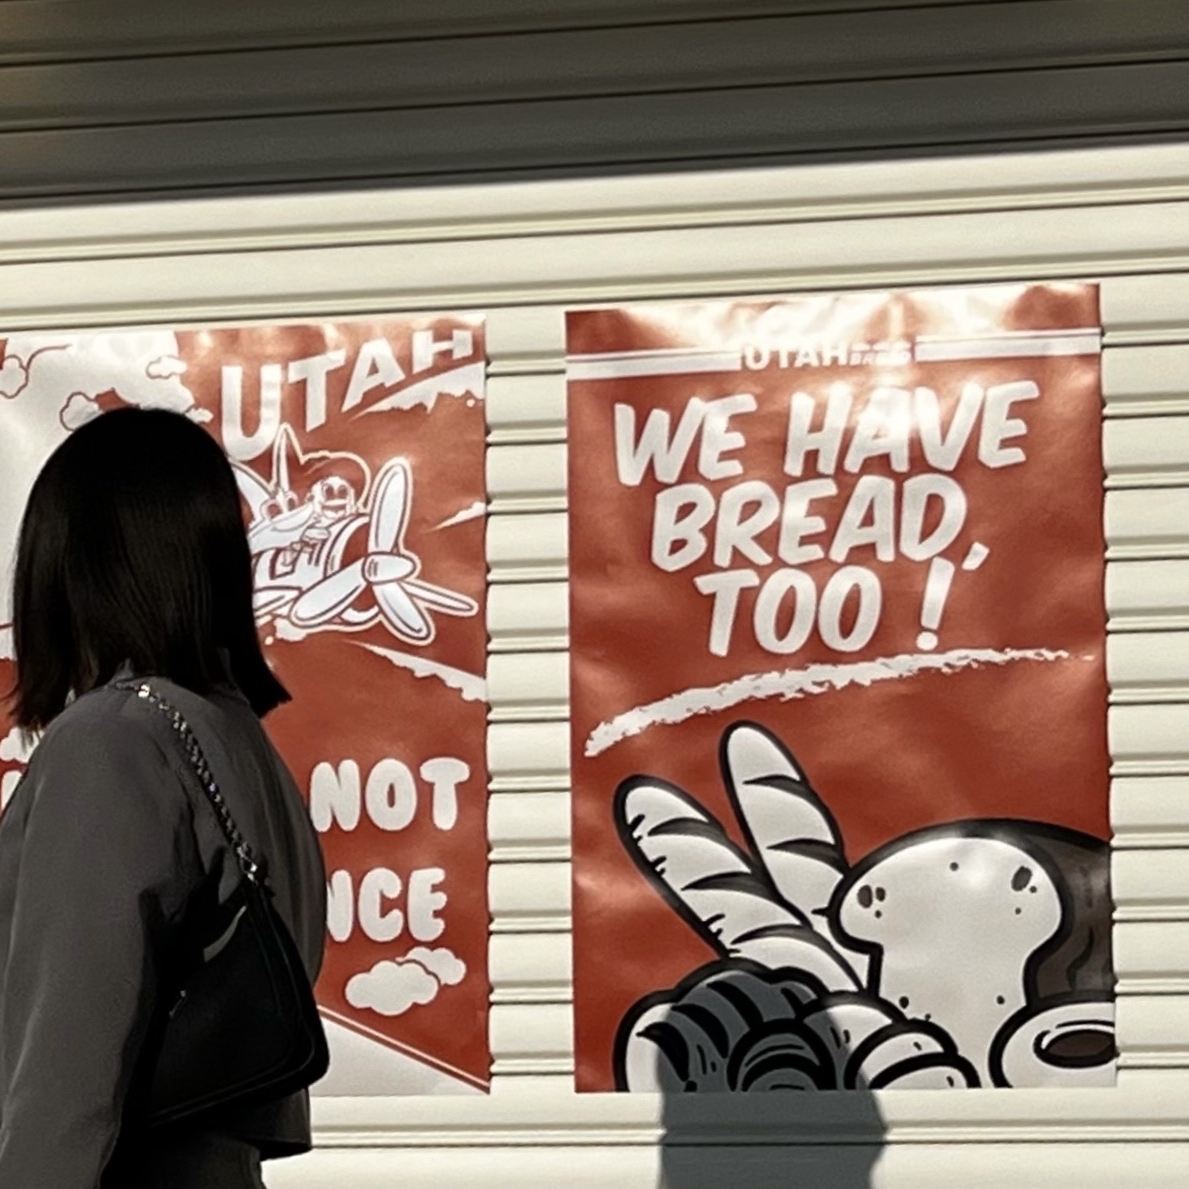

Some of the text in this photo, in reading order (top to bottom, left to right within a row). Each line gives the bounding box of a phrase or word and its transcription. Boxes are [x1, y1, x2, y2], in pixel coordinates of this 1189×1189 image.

[222, 330, 473, 460] UTAH
[745, 344, 848, 370] UTAH
[614, 380, 1040, 486] WE HAVE
[652, 474, 989, 571] BREAD,
[694, 566, 882, 656] TOO
[311, 757, 470, 832] NOT
